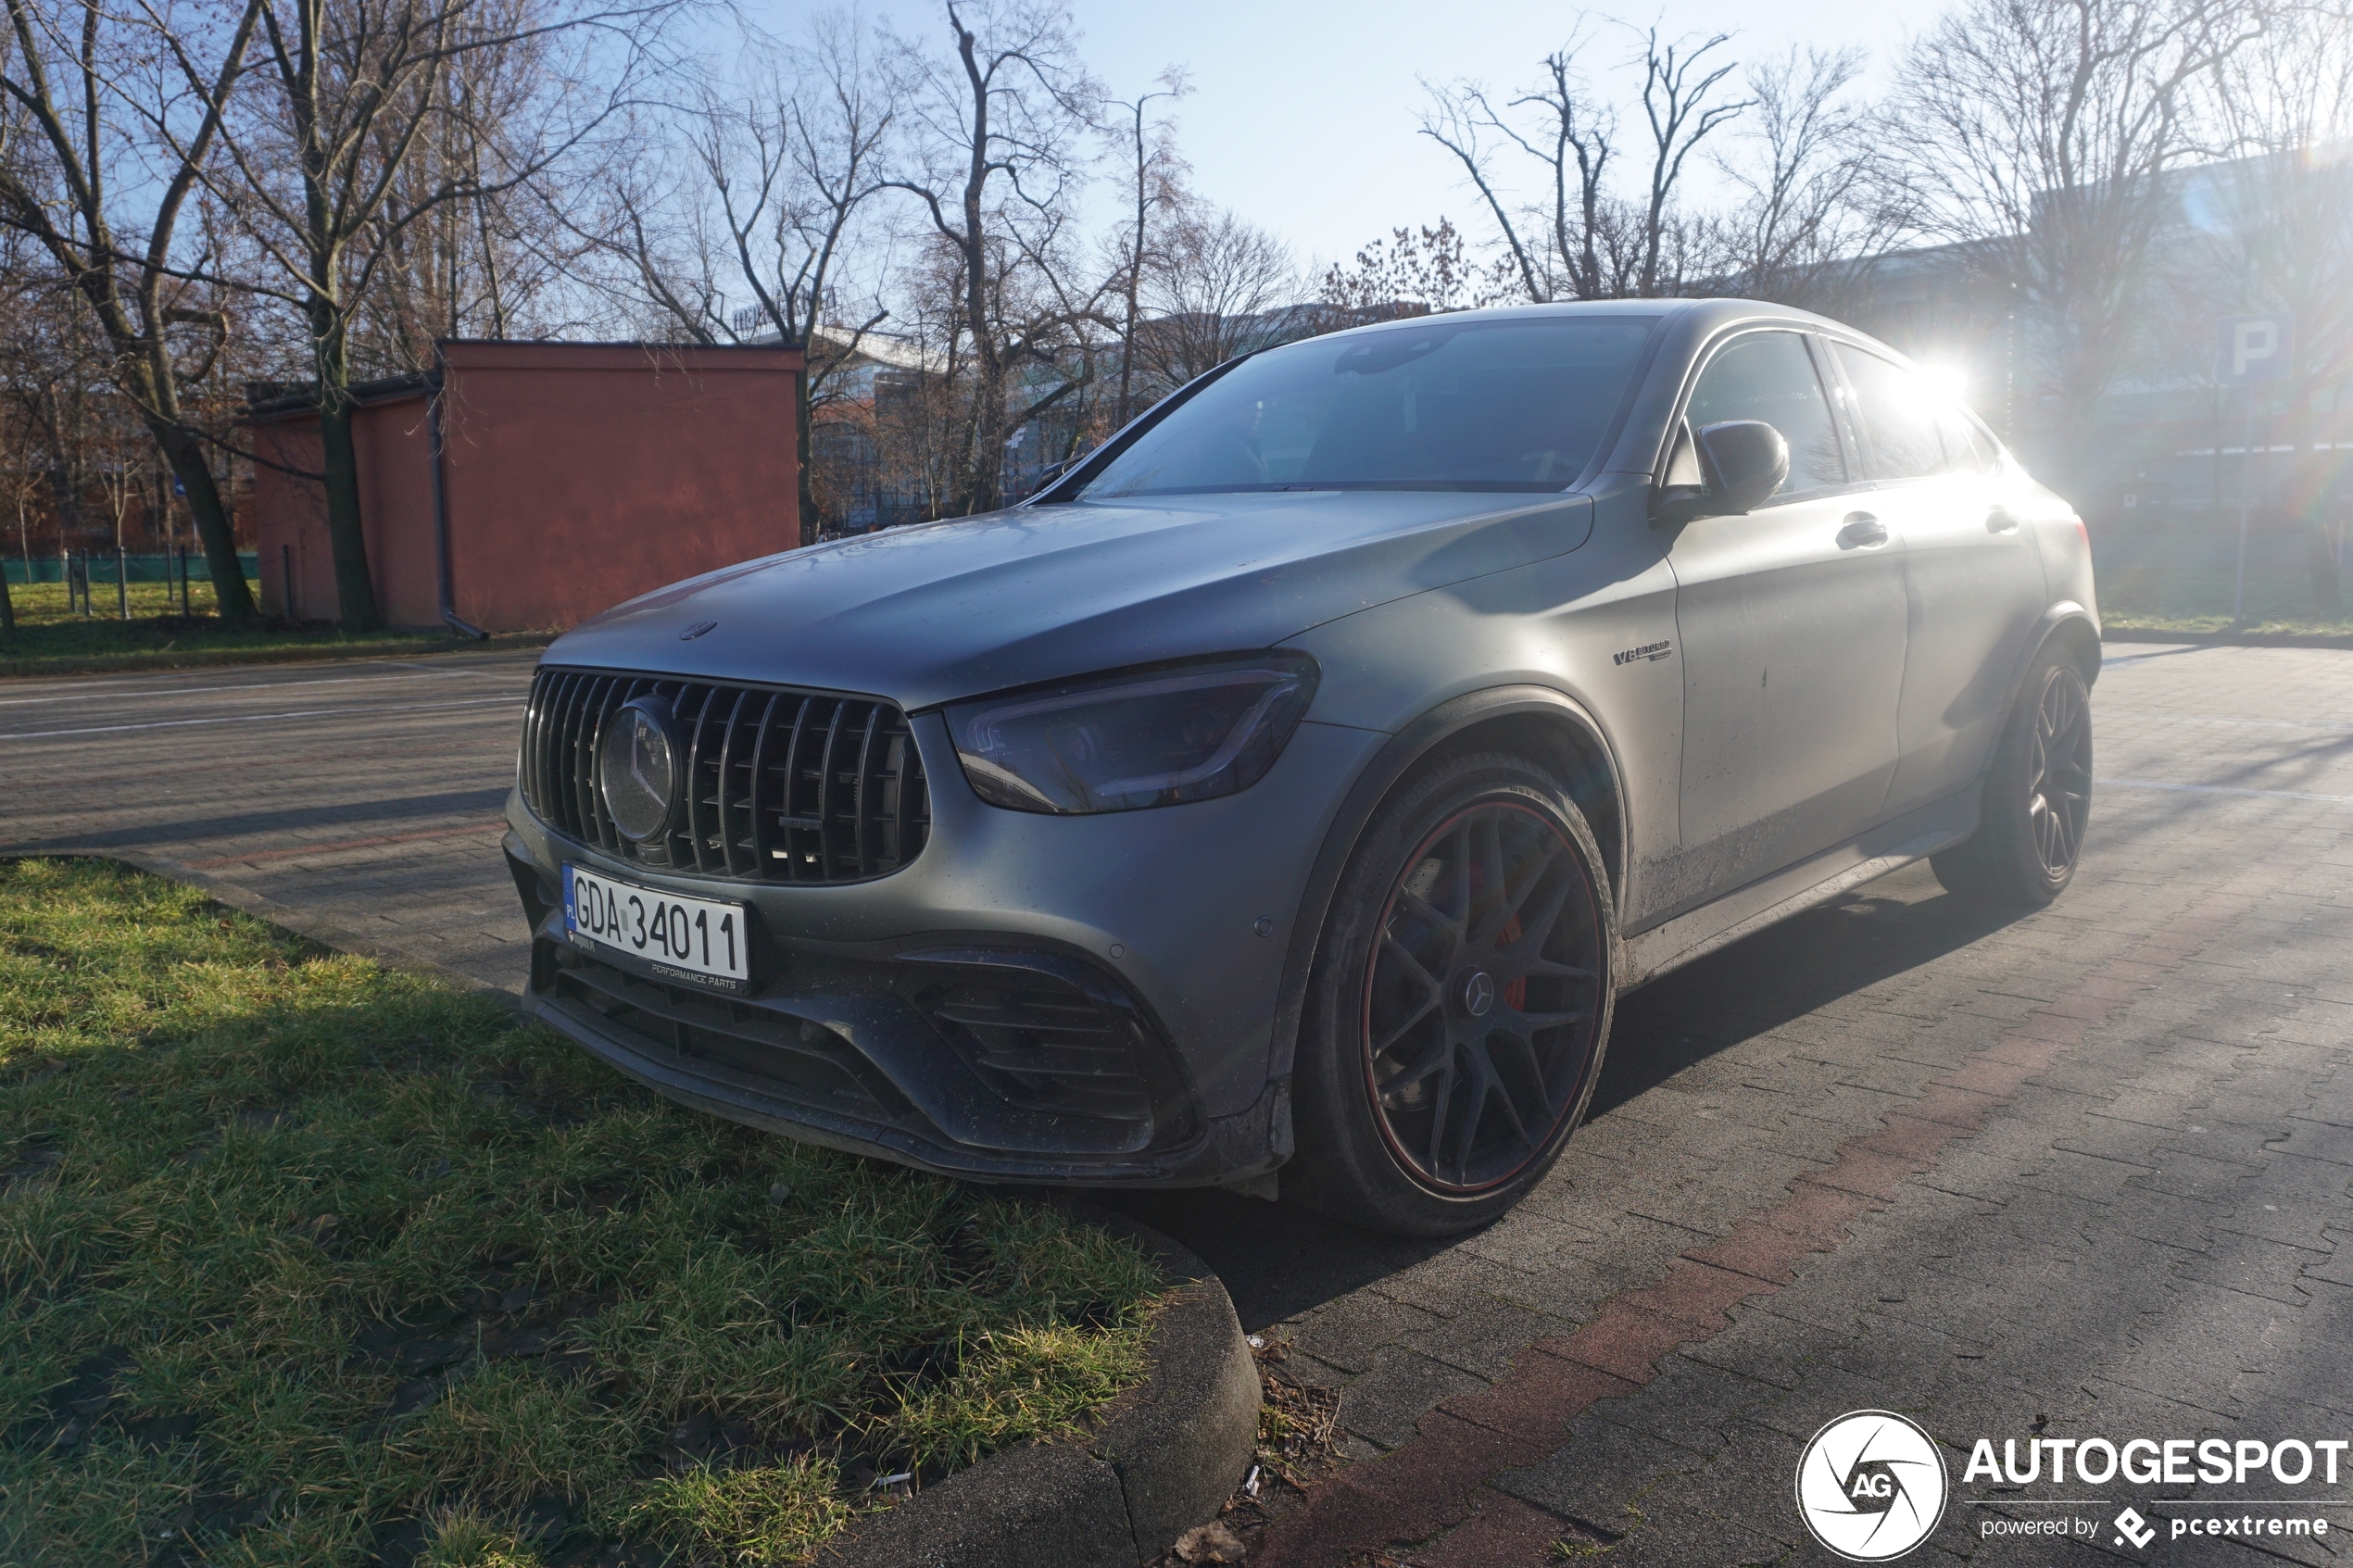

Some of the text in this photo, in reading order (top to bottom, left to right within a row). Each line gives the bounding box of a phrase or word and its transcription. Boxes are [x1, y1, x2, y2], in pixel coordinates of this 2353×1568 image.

[2233, 320, 2278, 375] P
[566, 903, 575, 920] PL
[574, 876, 736, 971] GDA 34011
[651, 963, 737, 990] PERFORMANCE PARTS
